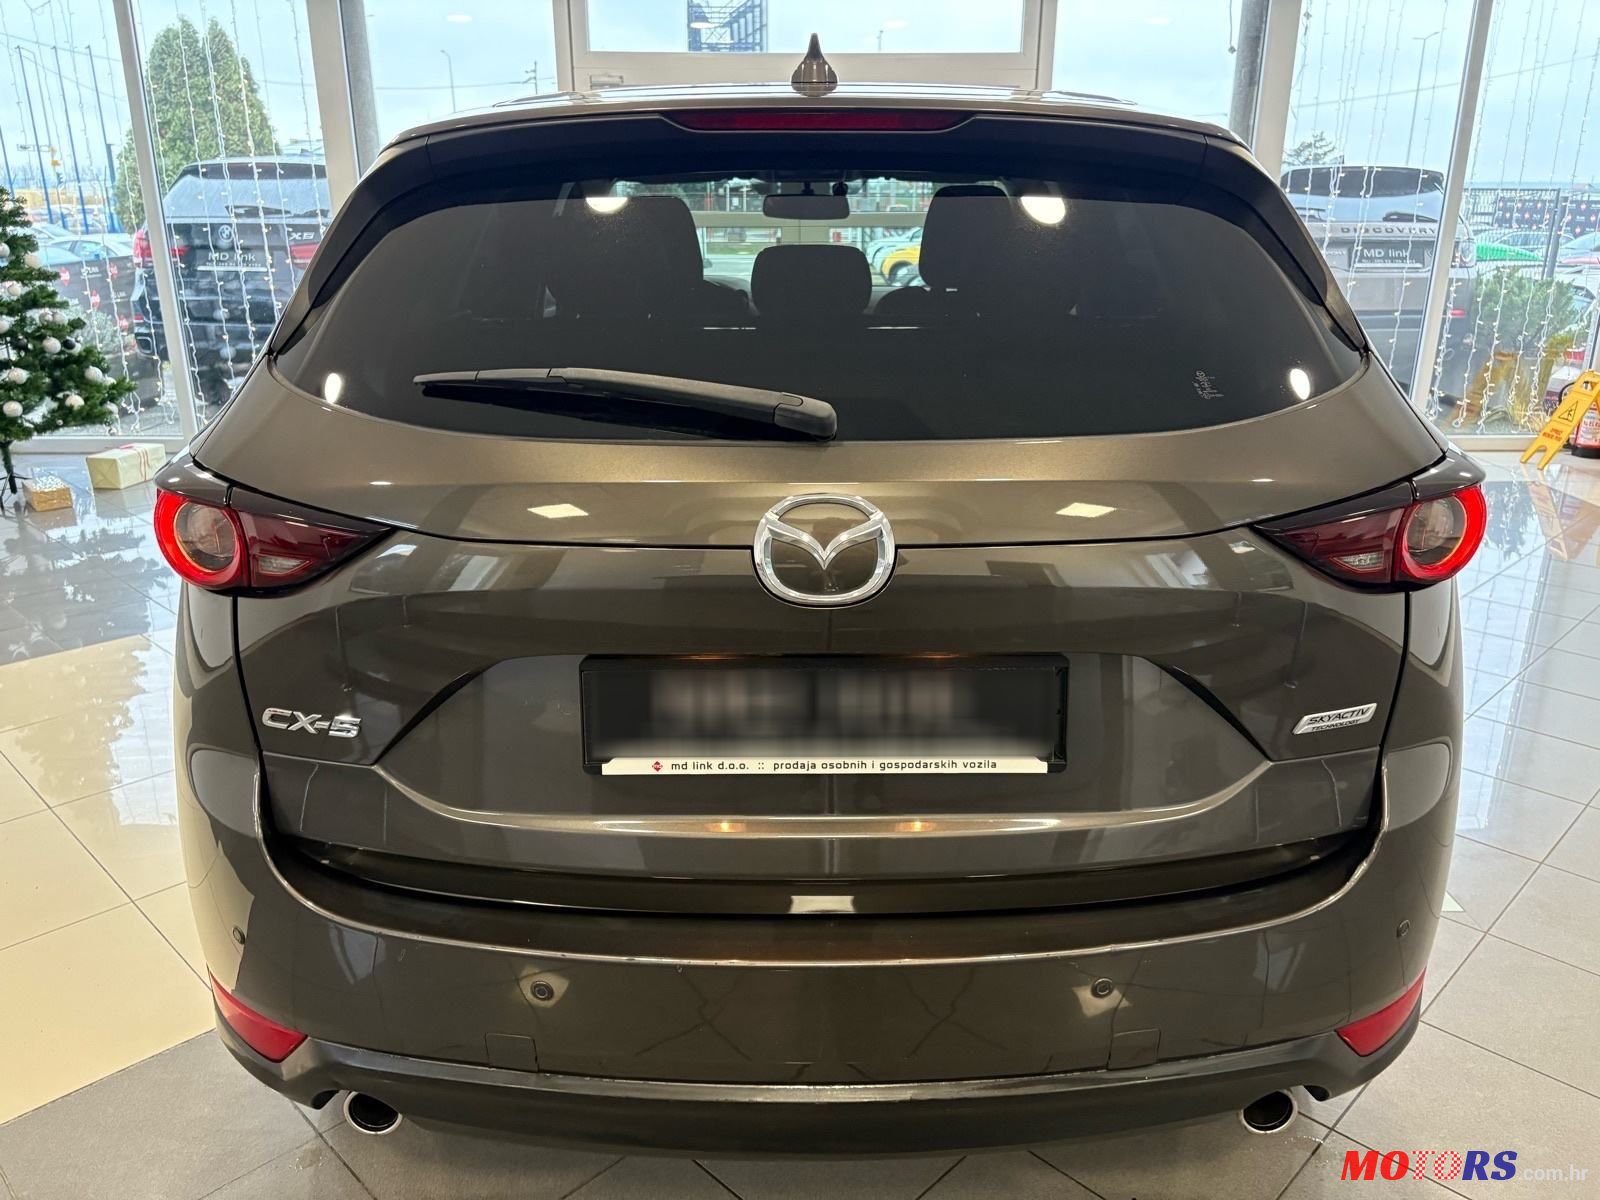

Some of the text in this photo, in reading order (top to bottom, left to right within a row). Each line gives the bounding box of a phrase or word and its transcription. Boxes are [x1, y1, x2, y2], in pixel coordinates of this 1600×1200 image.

[208, 251, 256, 261] MD lnk
[1363, 248, 1409, 258] MD link
[1307, 706, 1370, 725] SKYACTIV
[262, 707, 361, 738] CX-5
[1312, 719, 1361, 731] TECHNOLOGY
[671, 761, 688, 770] md
[692, 761, 713, 770] link
[717, 761, 749, 770] d.o.o.
[773, 761, 817, 771] prodaja
[821, 760, 867, 770] osobnih
[879, 760, 958, 771] gospodarskih
[962, 759, 997, 769] vozila
